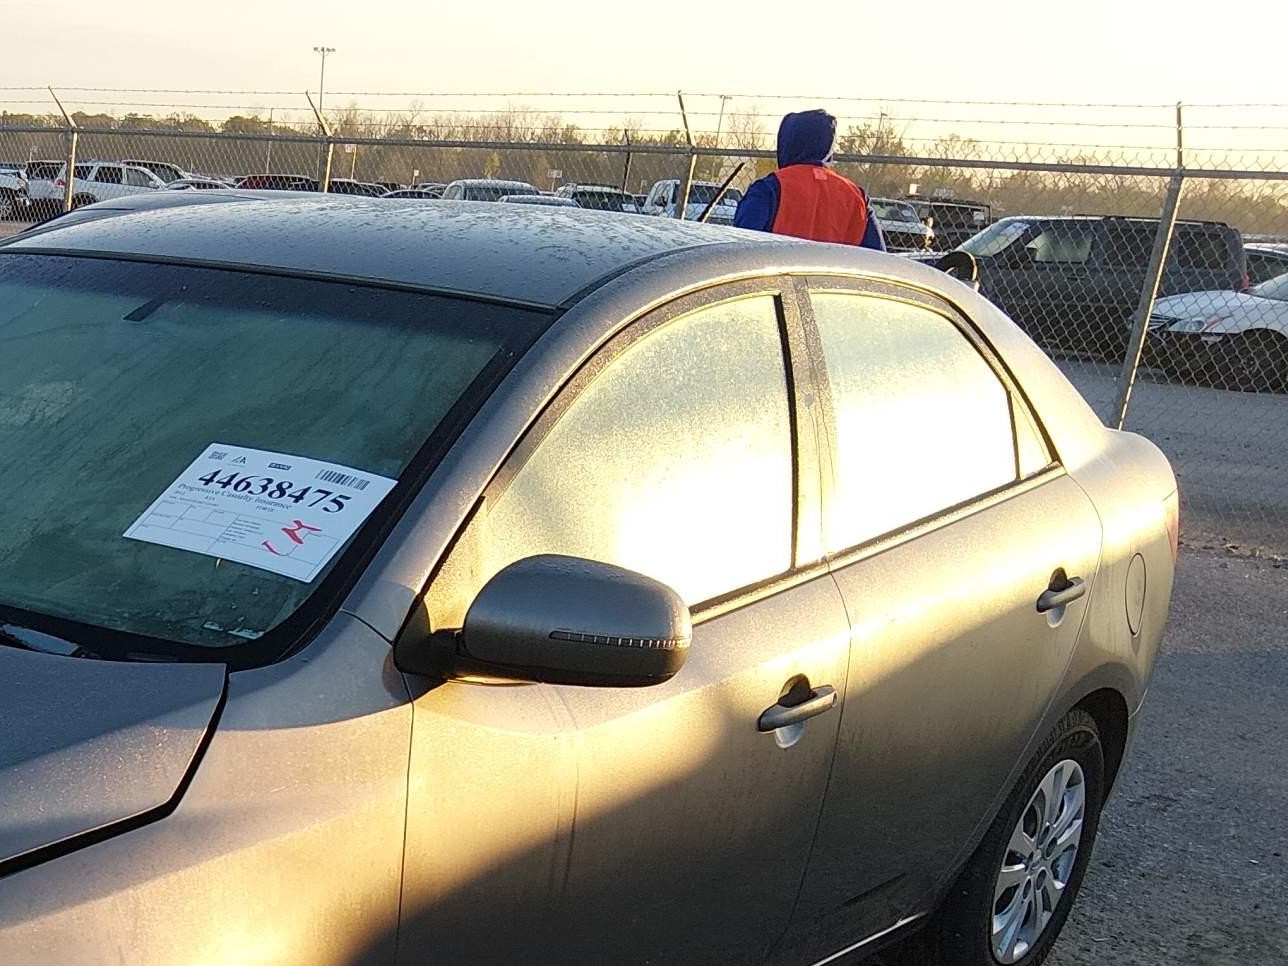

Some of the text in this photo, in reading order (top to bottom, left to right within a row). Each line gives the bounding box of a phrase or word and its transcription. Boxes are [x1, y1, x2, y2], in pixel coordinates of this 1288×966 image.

[178, 483, 220, 495] Progressive
[221, 490, 252, 502] Casualty
[254, 497, 292, 509] Insurance
[198, 469, 352, 513] 44638475
